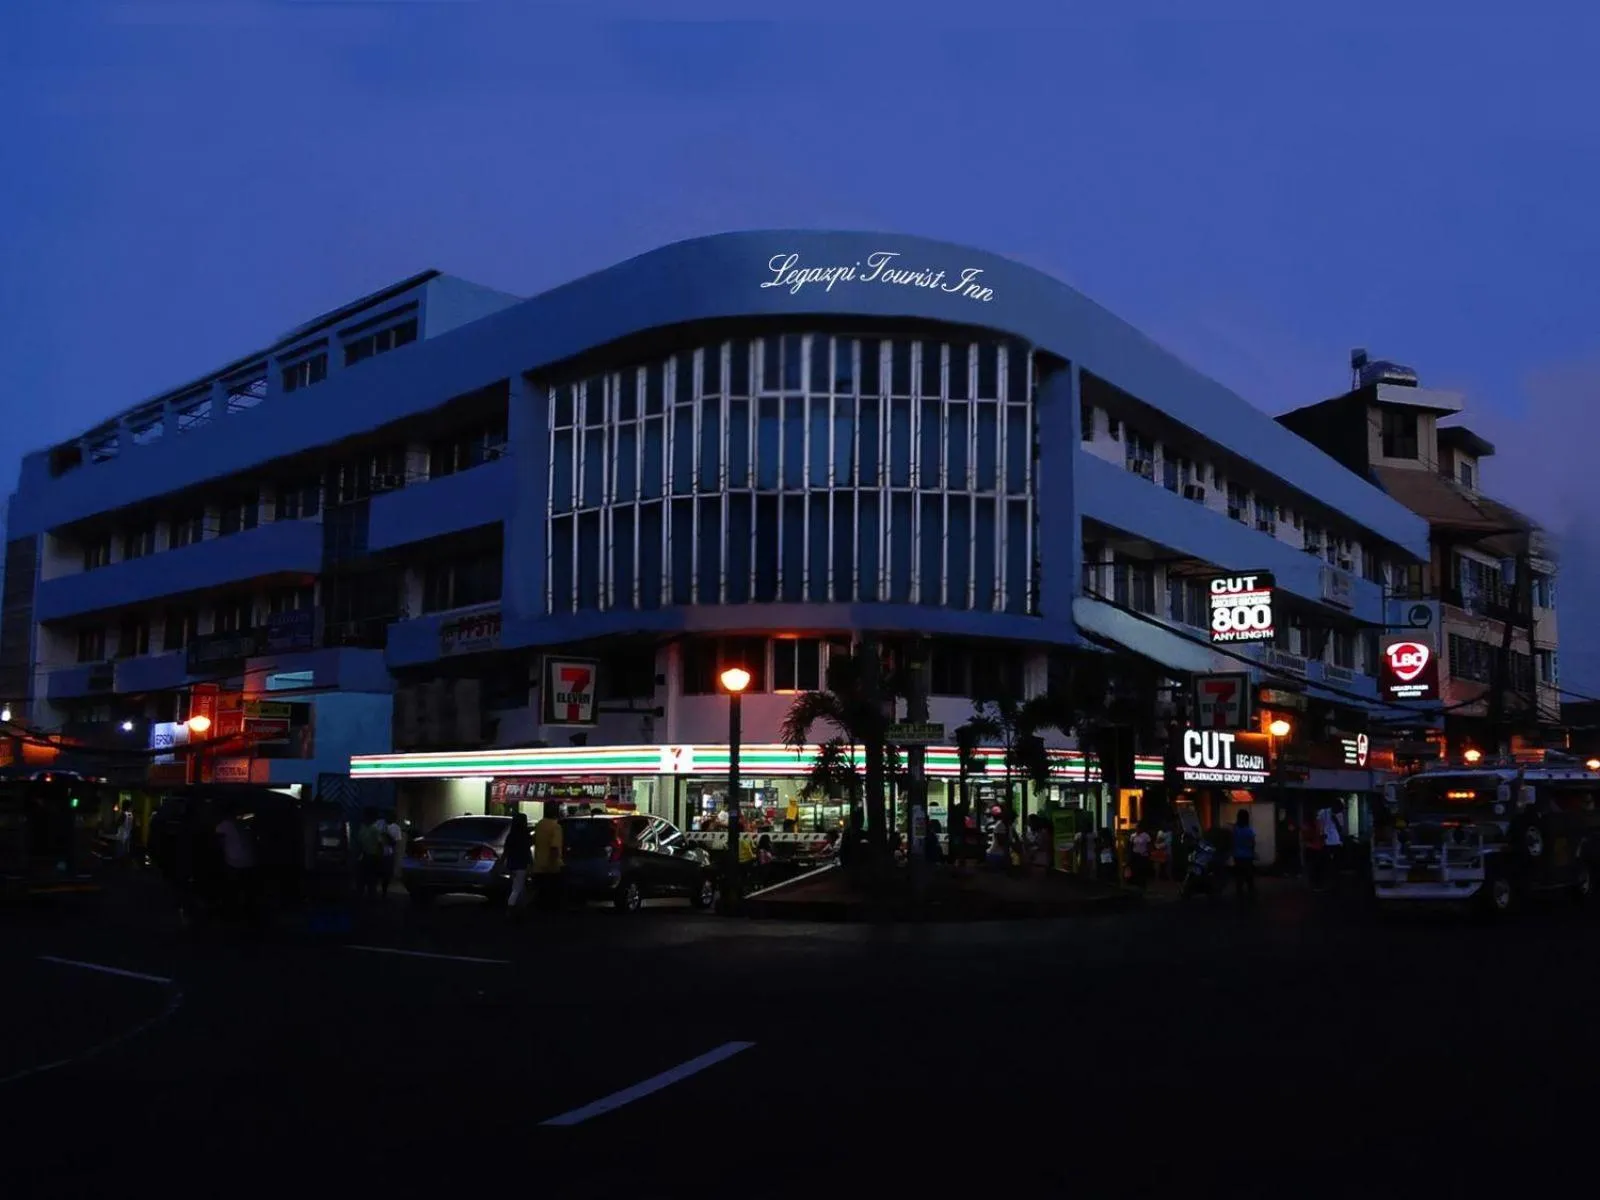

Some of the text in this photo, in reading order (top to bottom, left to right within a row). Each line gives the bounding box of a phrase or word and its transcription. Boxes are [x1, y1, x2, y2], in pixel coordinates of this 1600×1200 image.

[760, 251, 994, 302] Legazpi Tourist Inn
[1211, 576, 1257, 594] CUT
[1212, 604, 1271, 632] 800
[1213, 629, 1274, 641] ANY LENGTH
[1391, 652, 1424, 668] LBC
[560, 667, 590, 722] 7
[1184, 729, 1264, 769] CUT LEGAZPI
